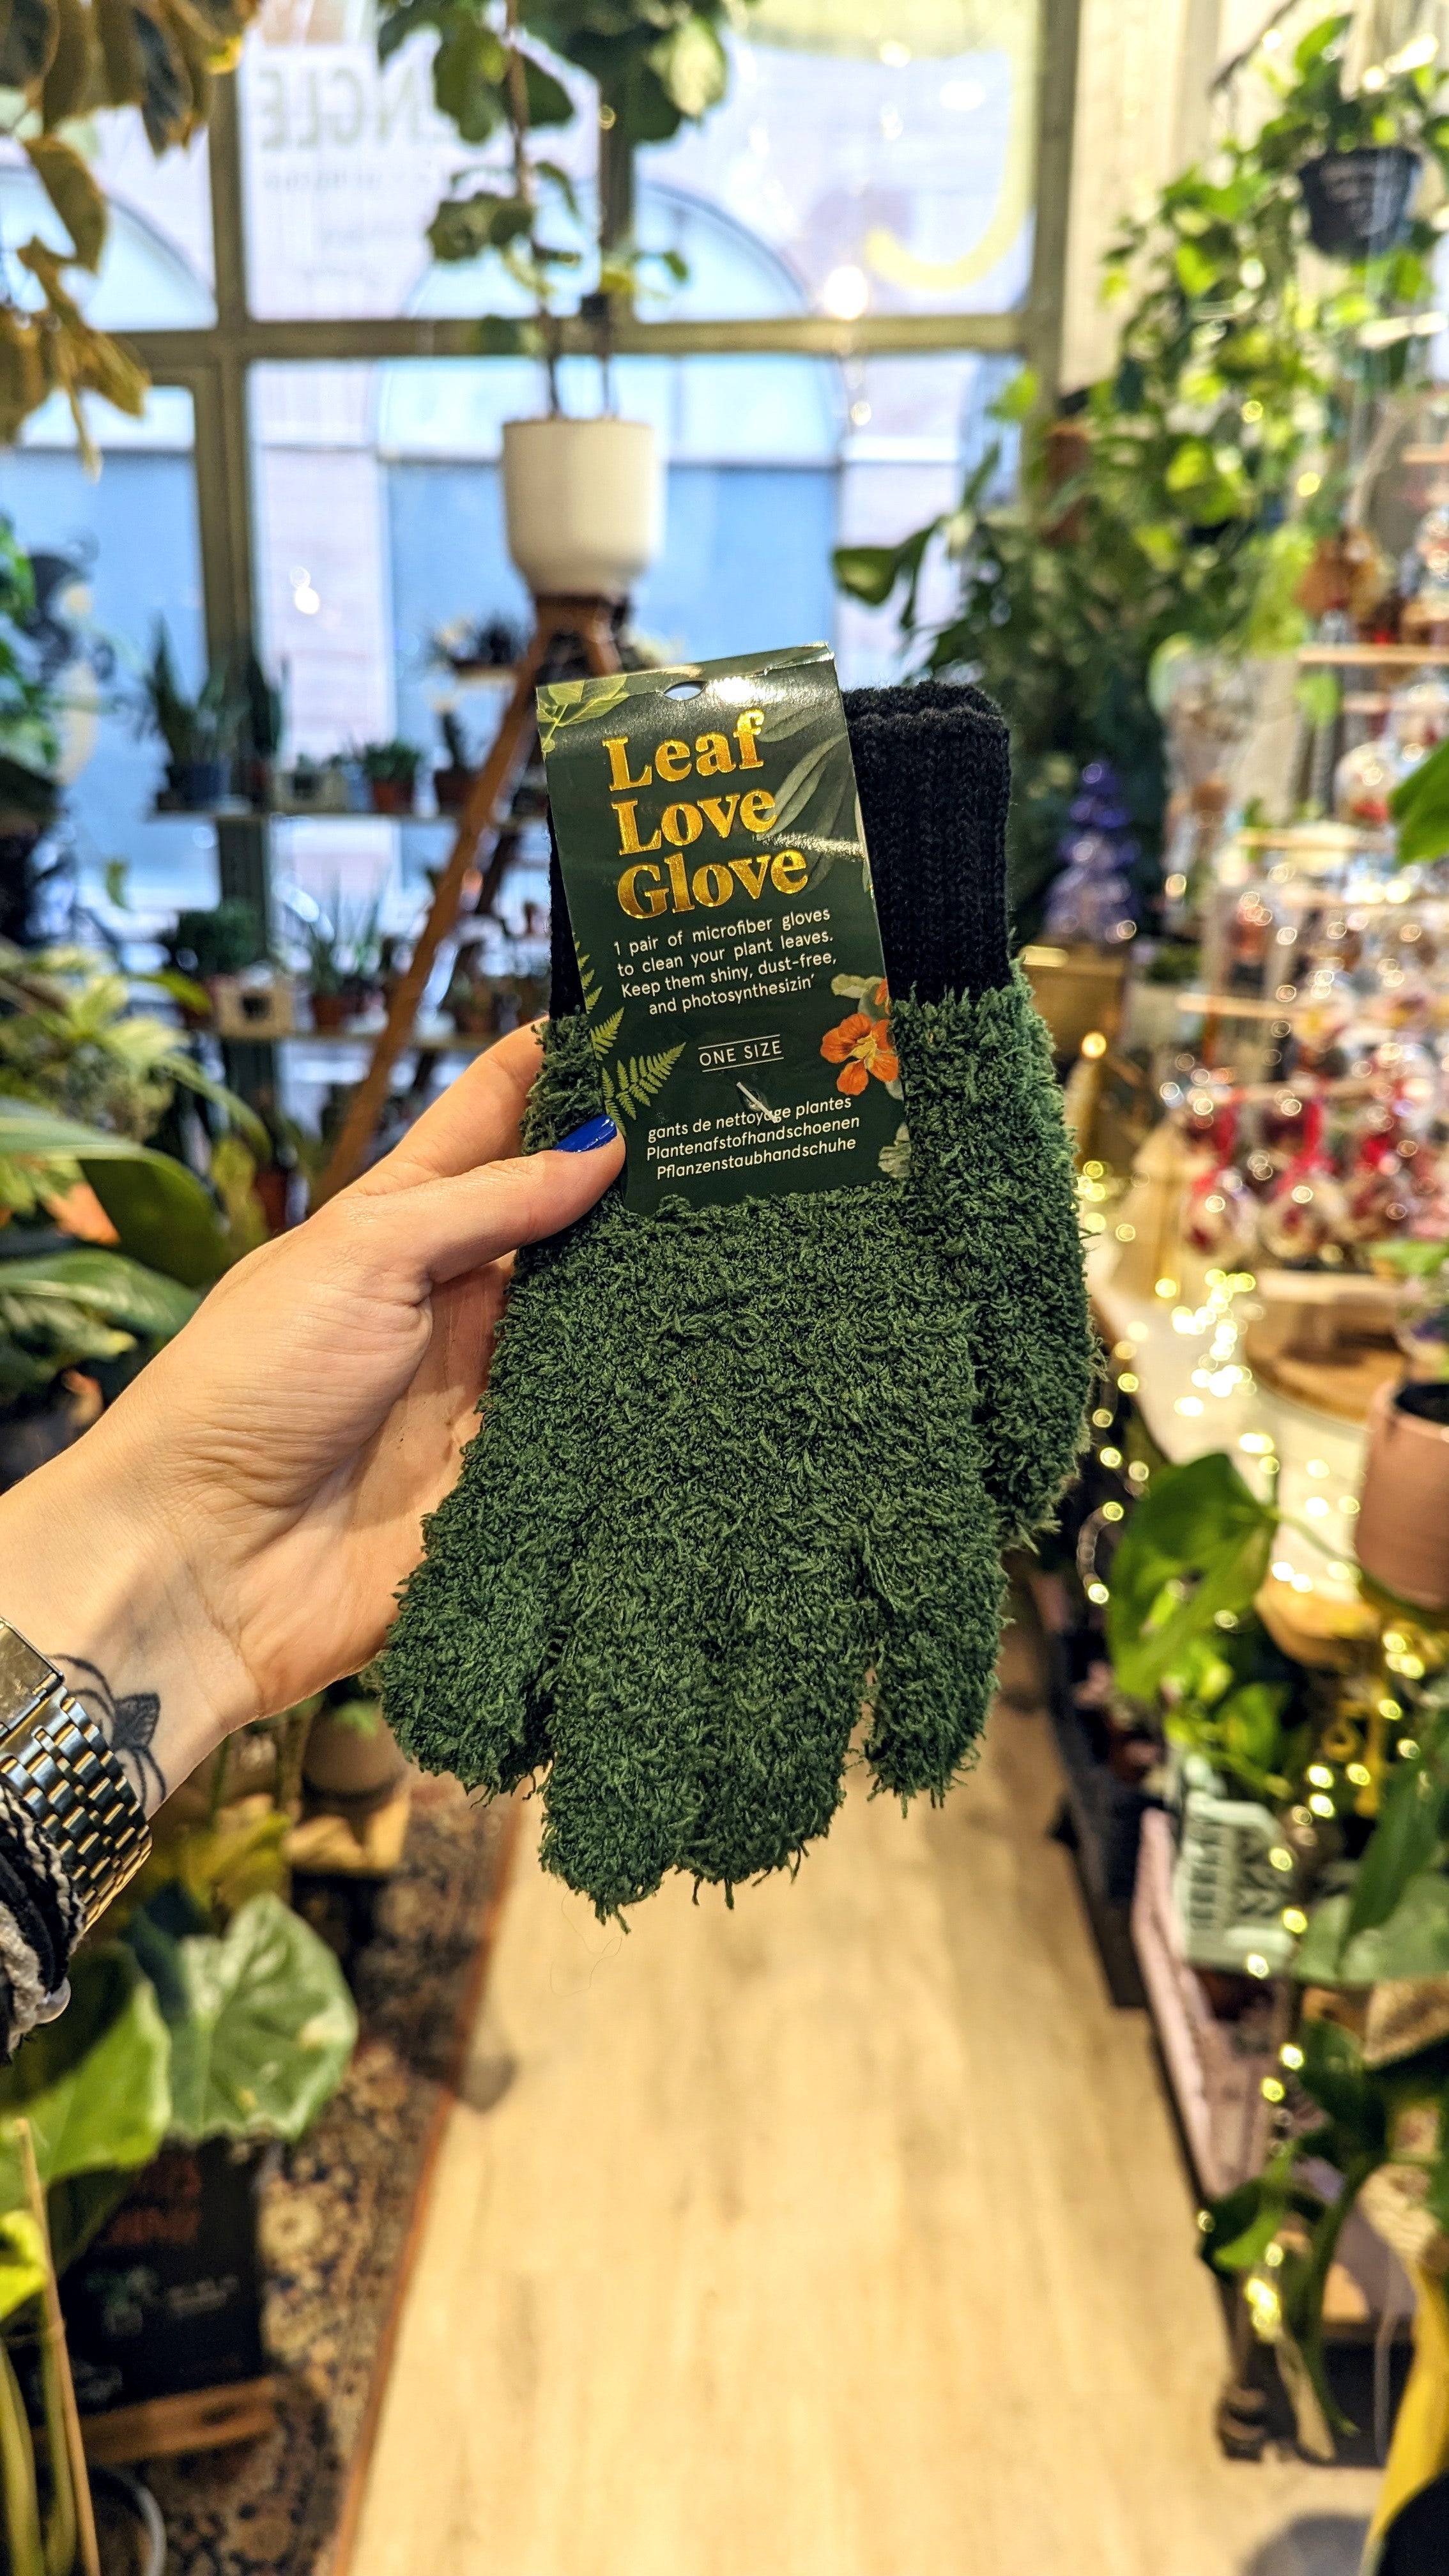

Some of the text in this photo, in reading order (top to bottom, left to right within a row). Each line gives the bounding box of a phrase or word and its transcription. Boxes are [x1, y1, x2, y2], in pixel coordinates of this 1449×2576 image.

[602, 708, 765, 792] Leaf
[610, 788, 778, 856] Love
[617, 849, 809, 919] Glove
[613, 908, 831, 957] 1 pair of microfiber gloves
[617, 931, 834, 977] to clean your plant leaves.
[621, 953, 838, 999] Keep them shiny, dust-free,
[649, 997, 678, 1015] and
[699, 1040, 783, 1067] ONE SIZE
[647, 1117, 860, 1161] Plantenafstofhandschoenen
[648, 1096, 852, 1144] gants de nettoyage plantes
[657, 1137, 857, 1181] Pflanzenstaubhandschuhe
